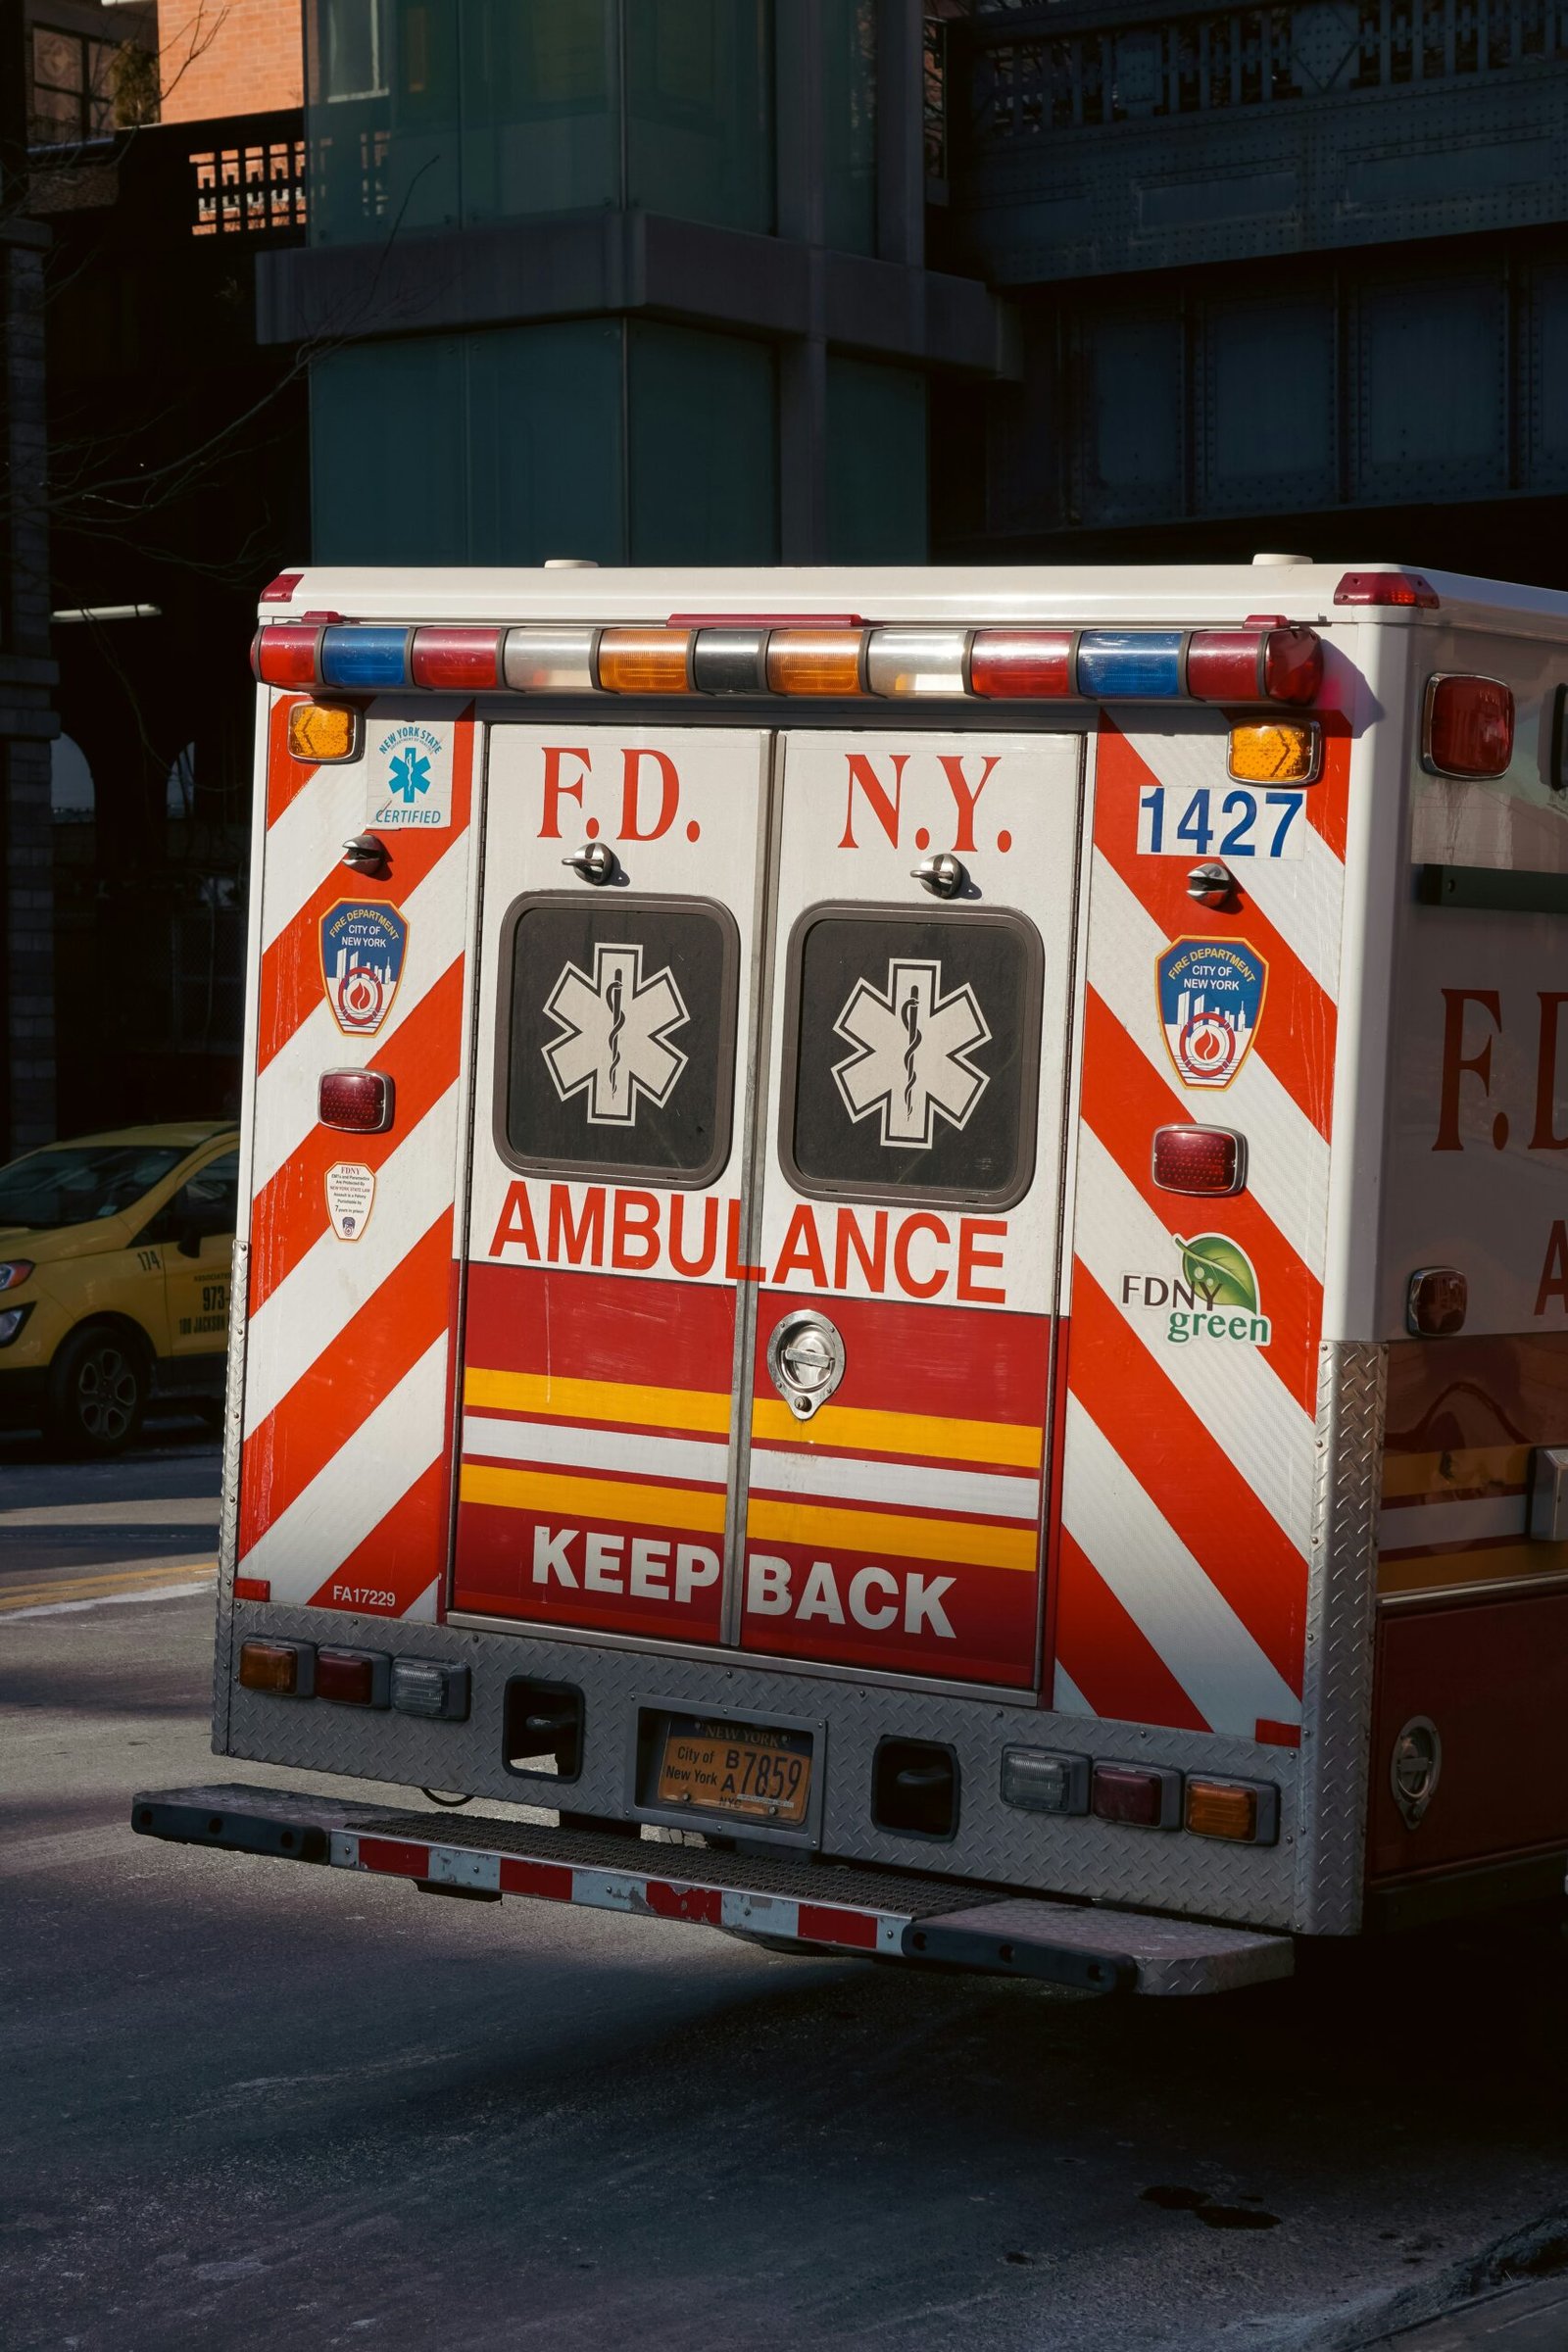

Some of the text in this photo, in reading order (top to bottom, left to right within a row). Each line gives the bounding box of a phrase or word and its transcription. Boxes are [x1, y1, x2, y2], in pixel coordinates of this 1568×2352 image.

[378, 726, 443, 755] NEW YORK STATE
[375, 809, 441, 824] CERTIFIED
[1141, 787, 1303, 858] 1427
[329, 908, 400, 941] FIRE DEPARTMENT
[348, 924, 381, 935] CITY OF
[341, 936, 387, 948] NEW YORK
[1167, 948, 1256, 983] FIRE DEPARTMENT
[1192, 965, 1233, 977] CITY OF
[1183, 978, 1240, 991] NEW YORK
[340, 1166, 361, 1175] FDNY
[488, 1180, 1008, 1305] AMBULANCE
[1122, 1274, 1223, 1312] FDNY
[1167, 1311, 1268, 1344] green
[532, 1525, 957, 1639] KEEP BACK
[332, 1585, 396, 1607] FA17229
[705, 1723, 780, 1748] NEW YORK
[677, 1745, 715, 1764] City of
[665, 1765, 717, 1786] New York
[718, 1795, 743, 1809] NYC
